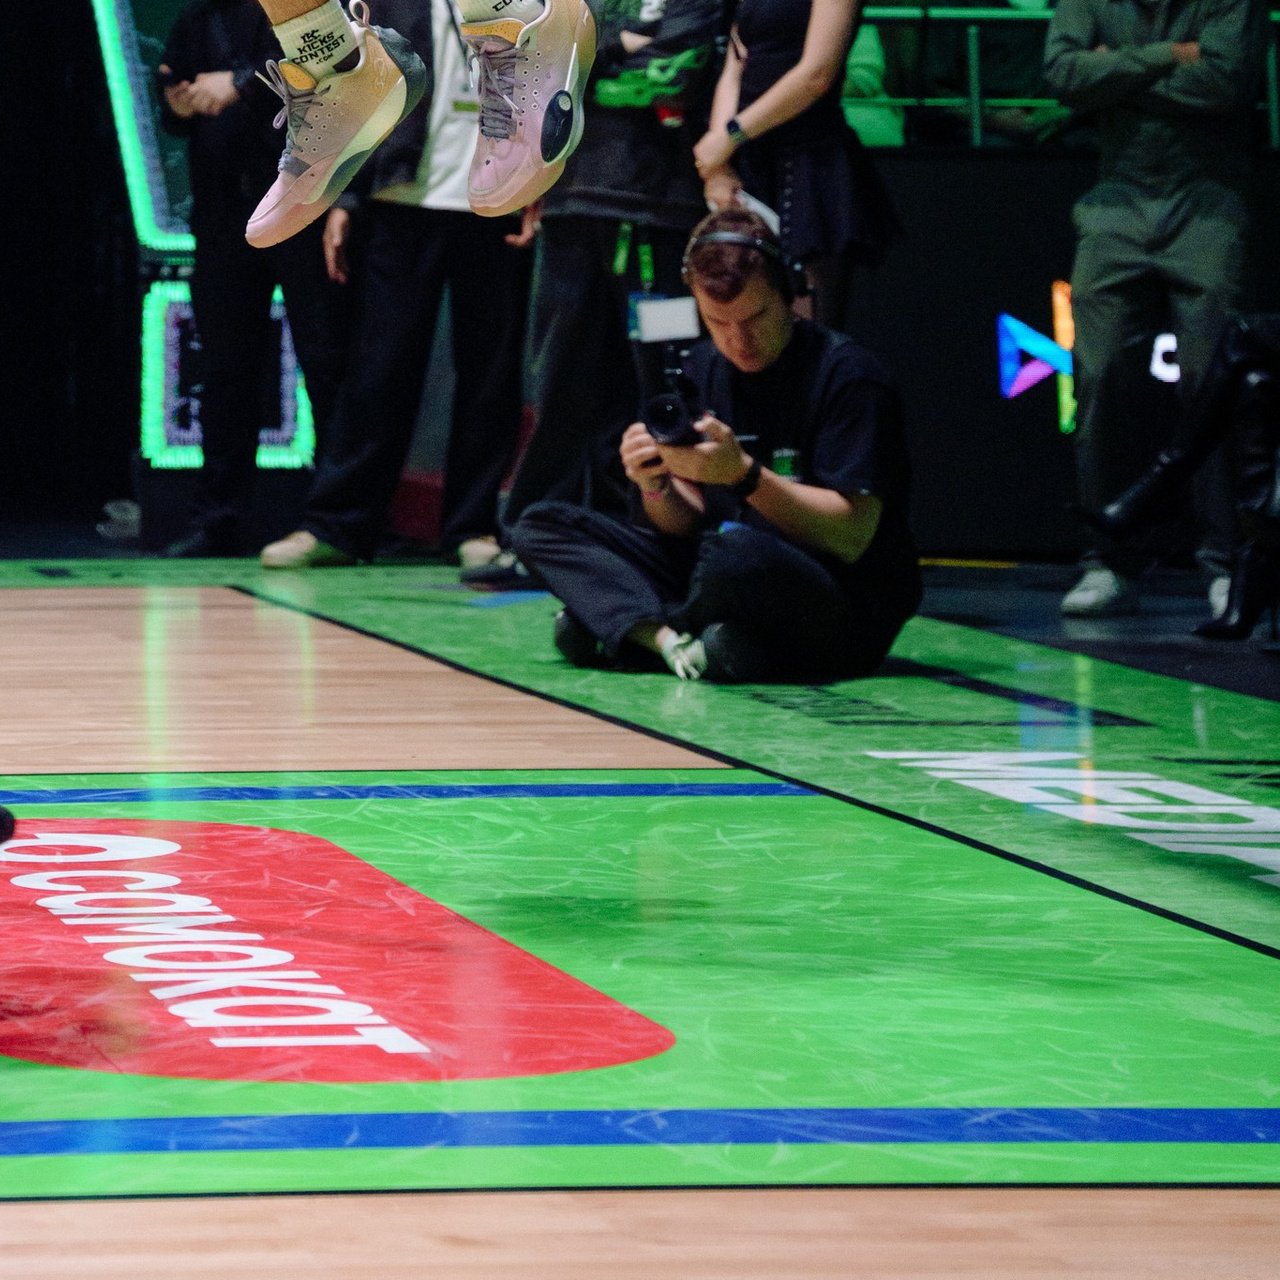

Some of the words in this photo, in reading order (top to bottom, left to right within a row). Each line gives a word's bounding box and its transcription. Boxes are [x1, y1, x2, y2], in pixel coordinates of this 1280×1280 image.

[291, 33, 346, 65] CONTEST
[297, 31, 335, 55] KICKS
[316, 52, 334, 65] .COM
